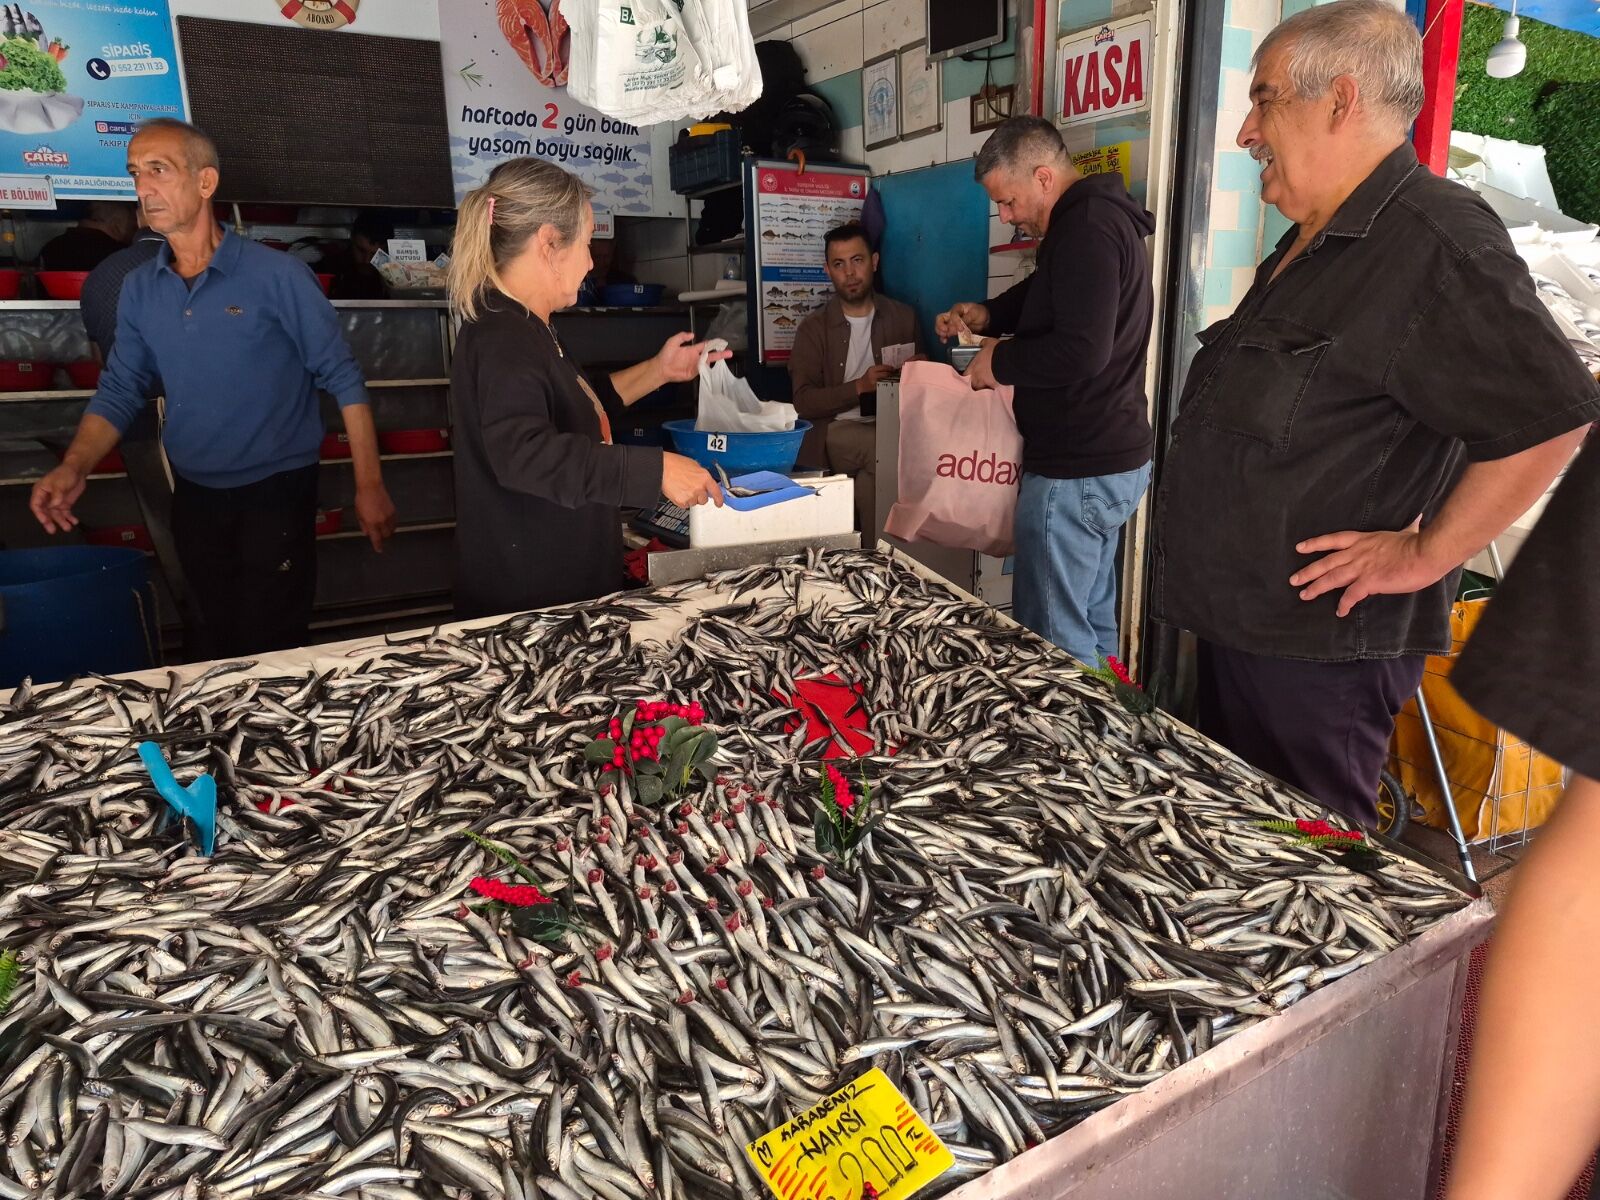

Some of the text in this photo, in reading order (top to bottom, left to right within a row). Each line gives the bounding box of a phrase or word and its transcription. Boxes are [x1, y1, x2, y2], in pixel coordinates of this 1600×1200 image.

[306, 13, 335, 25] ABOARD
[102, 41, 152, 58] SİPARİŞ
[111, 64, 117, 73] 0
[118, 63, 133, 72] 552
[133, 62, 146, 71] 231
[154, 61, 164, 70] 33
[1062, 39, 1143, 118] KASA
[461, 105, 538, 128] haftada
[541, 103, 559, 129] 2
[564, 114, 596, 135] gün
[23, 151, 69, 165] ÇARŞI
[468, 136, 638, 165] yaşam boyu sağlık.
[11, 186, 49, 201] BÖLÜMÜ
[710, 438, 724, 450] 42
[936, 450, 1022, 486] addax
[796, 1103, 867, 1169] HAMSİ
